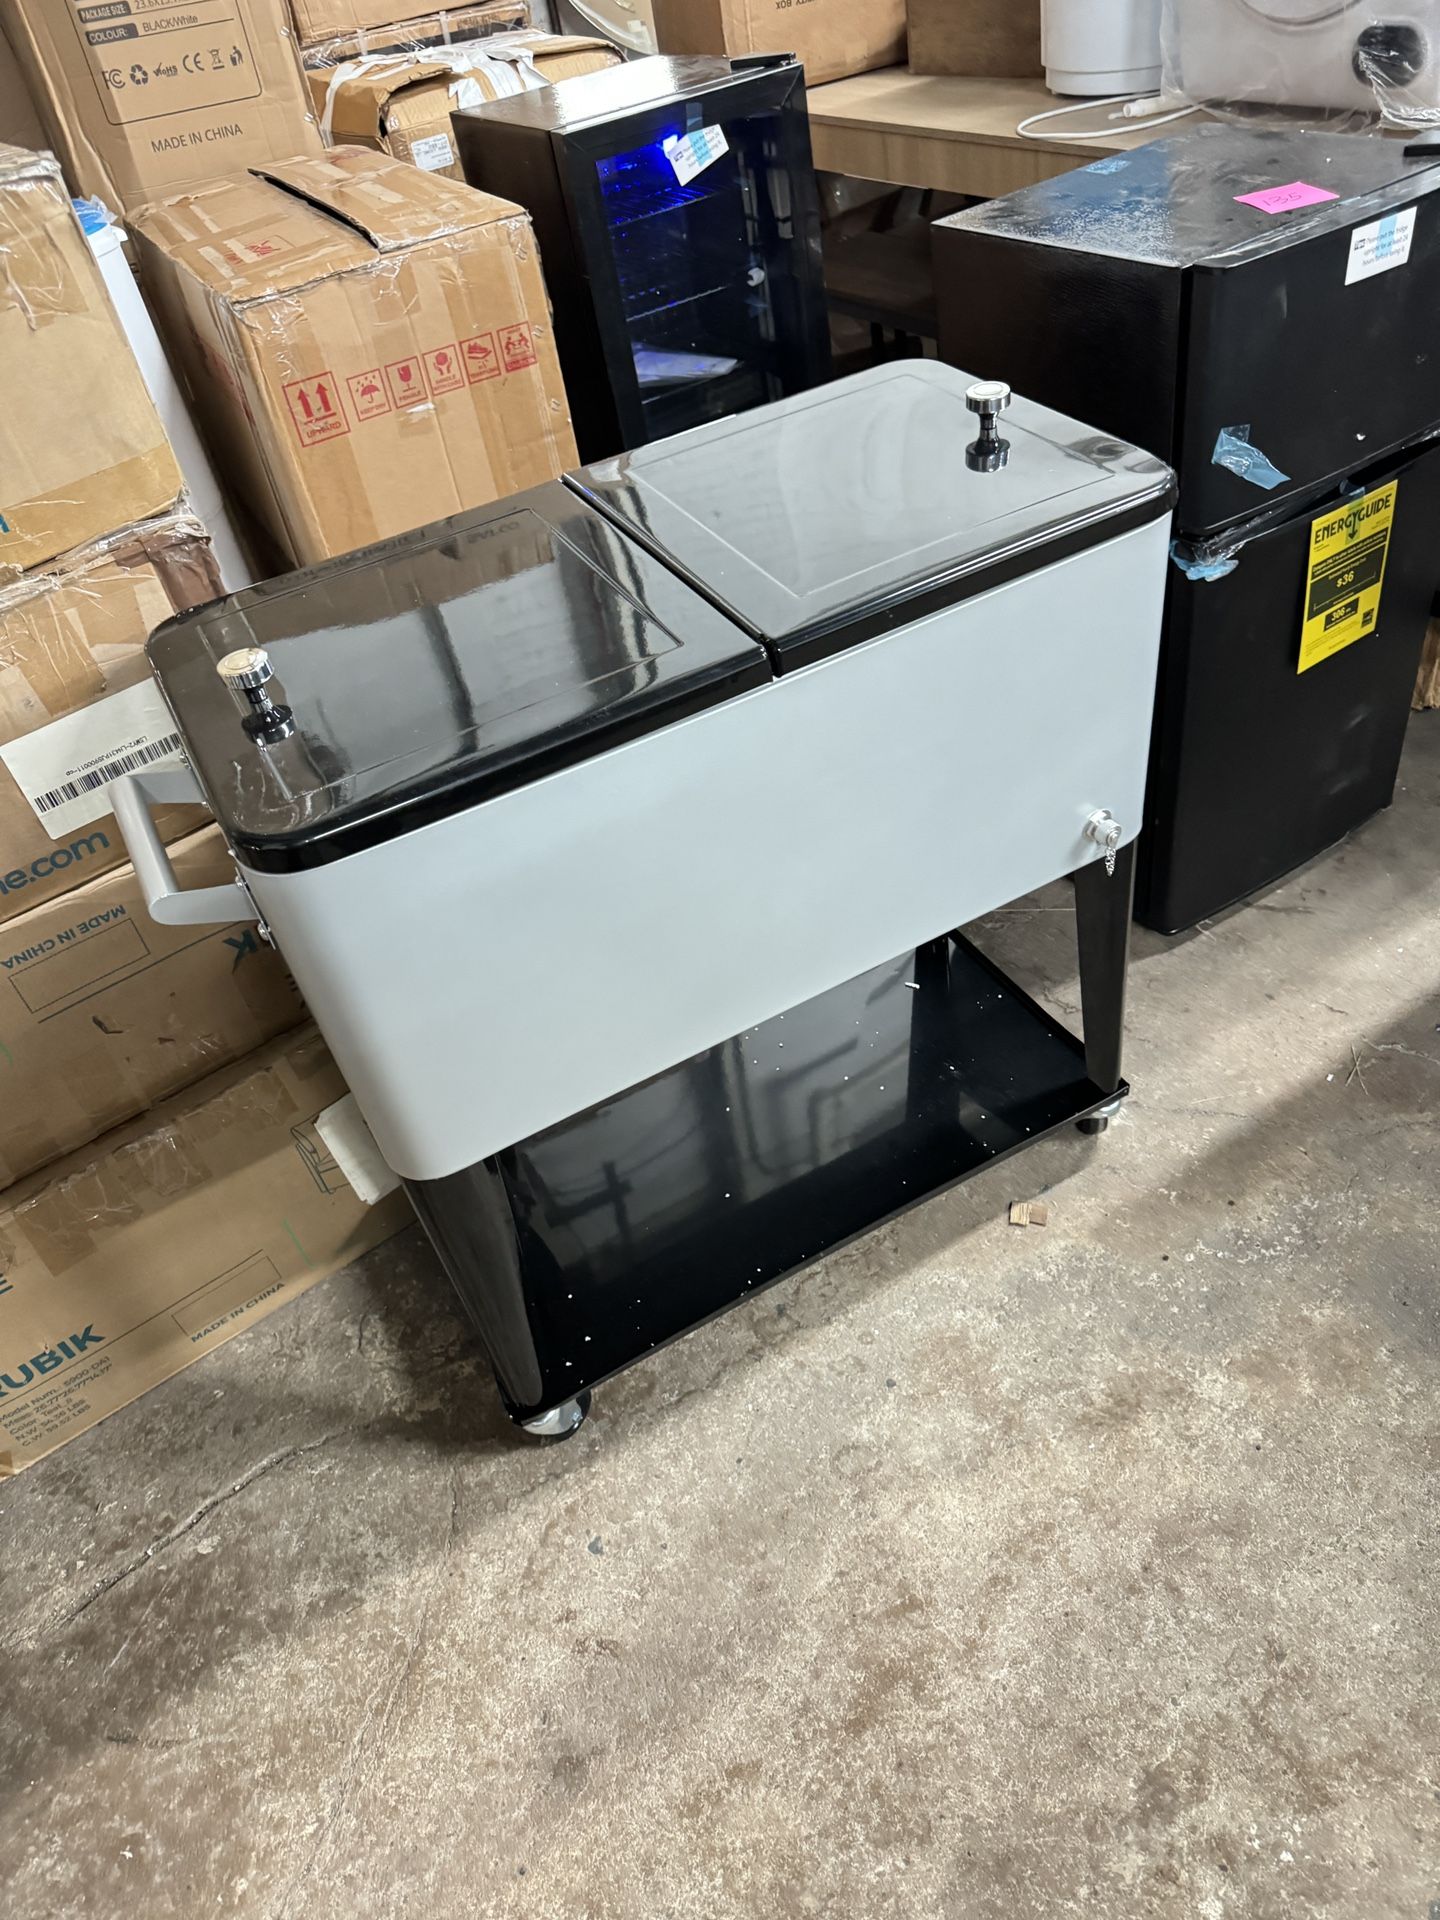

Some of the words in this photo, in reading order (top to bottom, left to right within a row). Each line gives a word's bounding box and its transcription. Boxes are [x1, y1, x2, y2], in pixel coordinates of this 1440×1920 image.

[80, 7, 112, 21] PACKAGE
[110, 4, 128, 16] SIZE:
[776, 0, 792, 9] BOX
[89, 27, 129, 43] COLOUR:
[142, 15, 199, 32] BLACK/White
[183, 52, 205, 74] CE
[151, 133, 188, 153] MADE
[189, 130, 204, 145] IN
[206, 123, 243, 142] CHINA
[1314, 493, 1392, 544] ENERGYGUIDE
[1336, 570, 1355, 588] $36
[79, 904, 126, 935] MADE
[56, 931, 77, 946] IN
[0, 938, 56, 969] CHINA
[191, 1316, 229, 1343] MADE
[230, 1307, 244, 1319] IN
[246, 1282, 285, 1309] CHINA
[0, 1402, 30, 1422] Model
